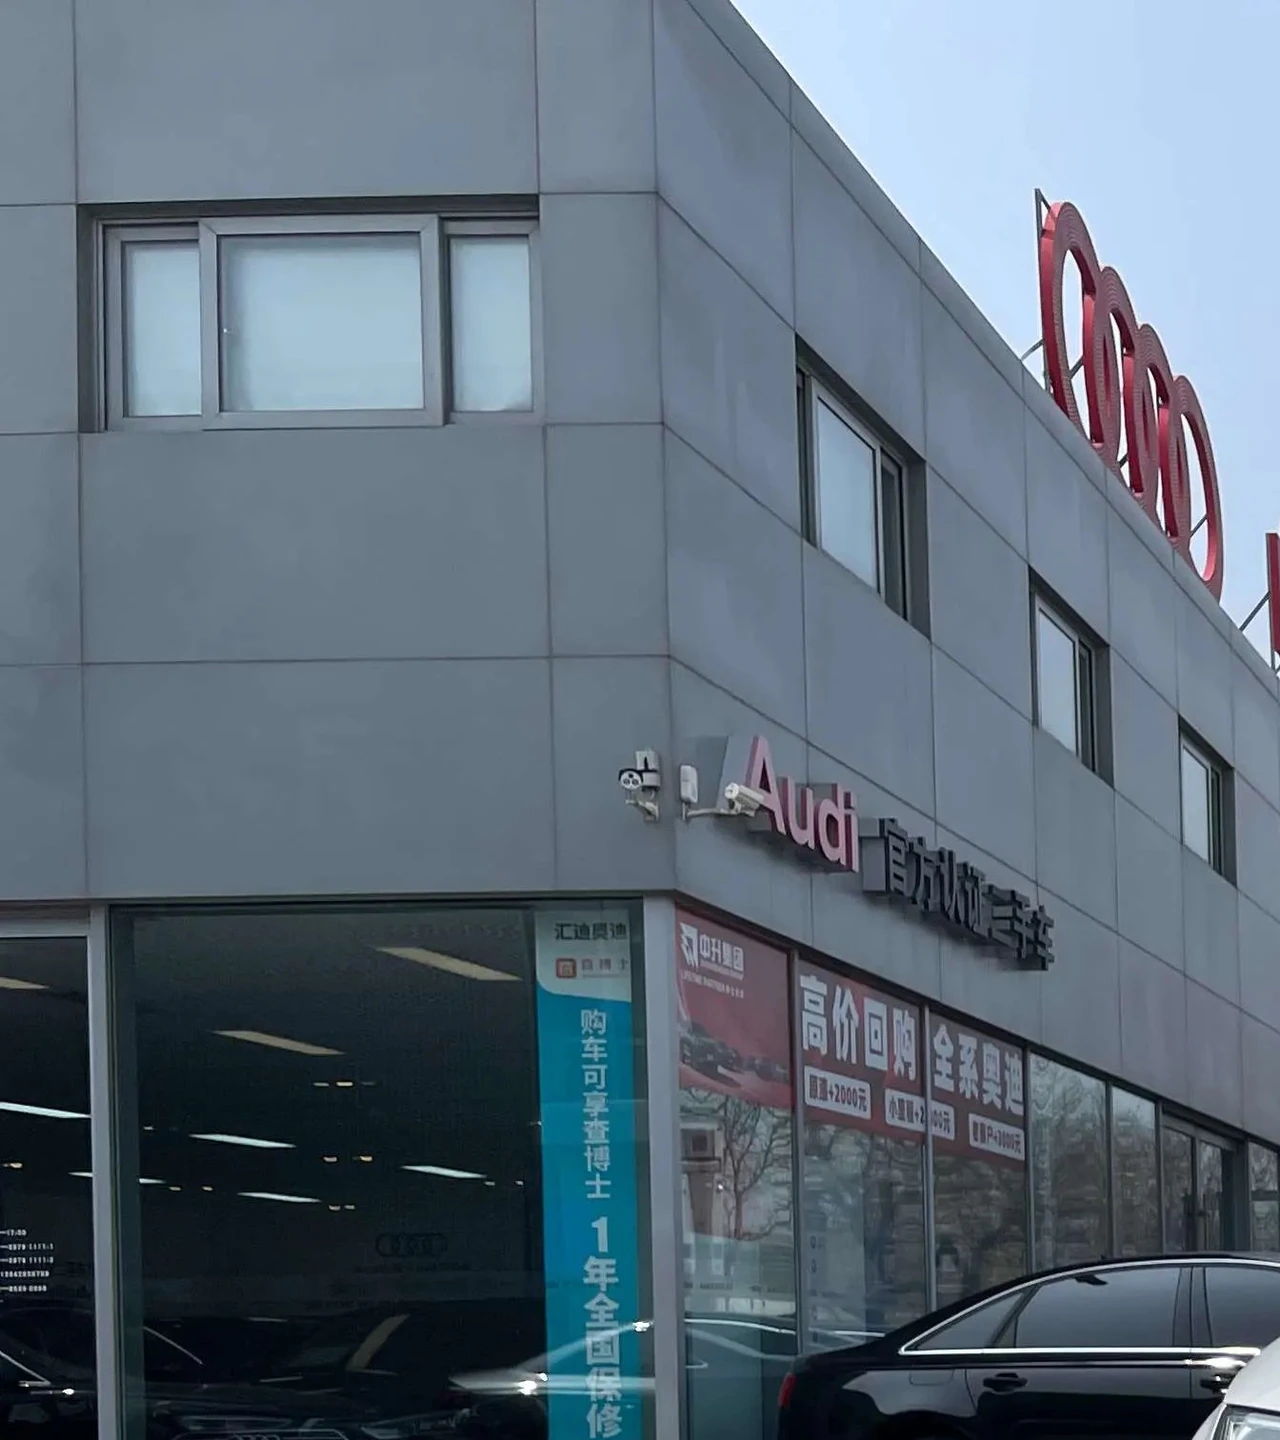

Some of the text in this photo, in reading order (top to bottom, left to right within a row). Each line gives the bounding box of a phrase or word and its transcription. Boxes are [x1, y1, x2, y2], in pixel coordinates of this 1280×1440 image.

[745, 735, 1056, 971] Audi 官方认证二手车
[580, 1009, 612, 1199] 购车可享查博士
[800, 975, 916, 1081] 高价回购
[932, 1023, 1024, 1116] 全系奥迪
[583, 1216, 622, 1440] 1年全国保修
